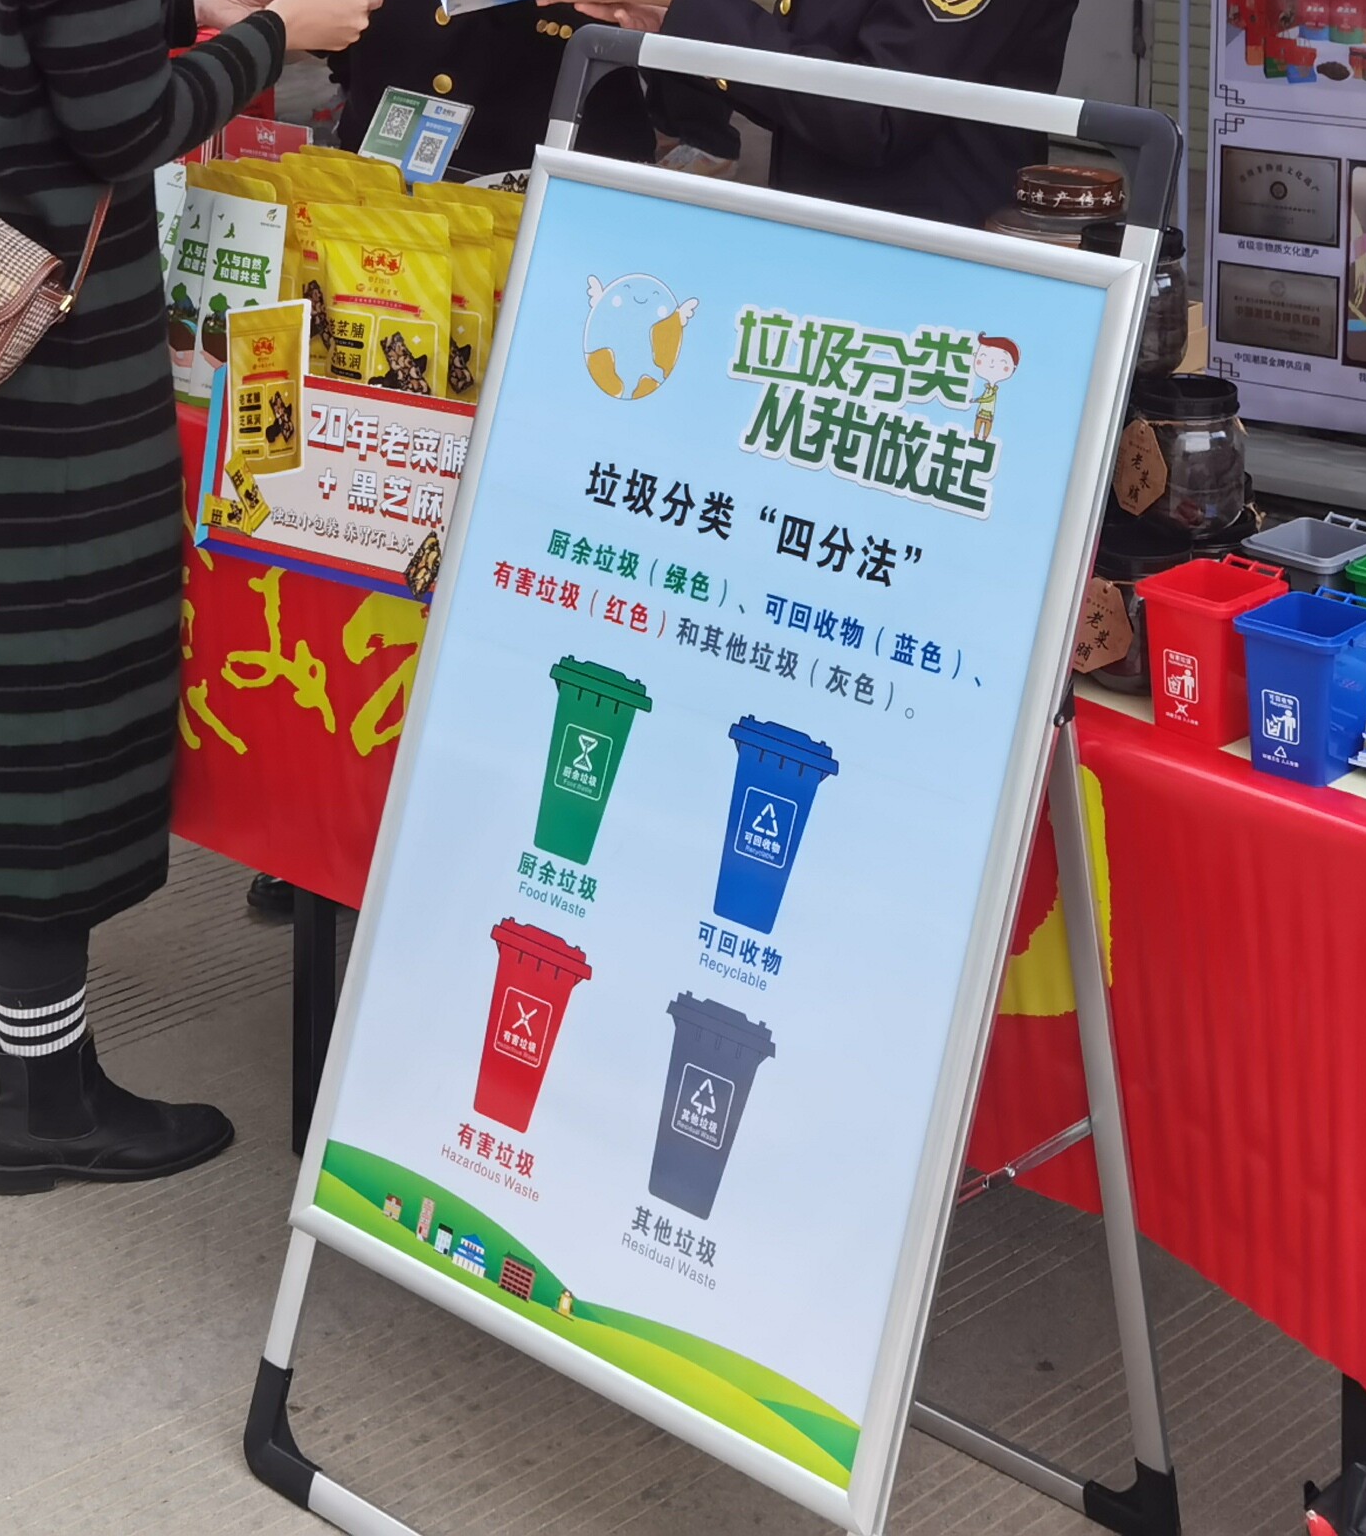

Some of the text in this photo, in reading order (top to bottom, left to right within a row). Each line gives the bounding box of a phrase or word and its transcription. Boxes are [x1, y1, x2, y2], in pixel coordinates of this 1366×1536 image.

[220, 267, 261, 286] 和谐共生
[221, 252, 263, 271] 人与自然
[733, 309, 973, 405] 垃圾分类
[744, 386, 996, 512] 从我做起
[348, 469, 443, 527] 黑芝麻
[271, 507, 414, 556] 独立小包装 养胃不上火
[585, 462, 924, 587] 垃圾分类“四分法”
[562, 766, 598, 788] 厨余垃圾
[744, 830, 781, 855] 可回收物
[517, 851, 599, 903] 厨余垃圾
[518, 881, 586, 919] Food Waste
[698, 921, 783, 976] 可回收物
[699, 952, 768, 992] Recyclable
[503, 1030, 537, 1054] 有害垃圾
[680, 1108, 718, 1135] 其他垃圾
[441, 1144, 540, 1202] Hazardous Waste
[457, 1122, 535, 1179] 有害垃圾
[621, 1232, 716, 1290] Residual Waste
[631, 1205, 717, 1268] 其他垃圾
